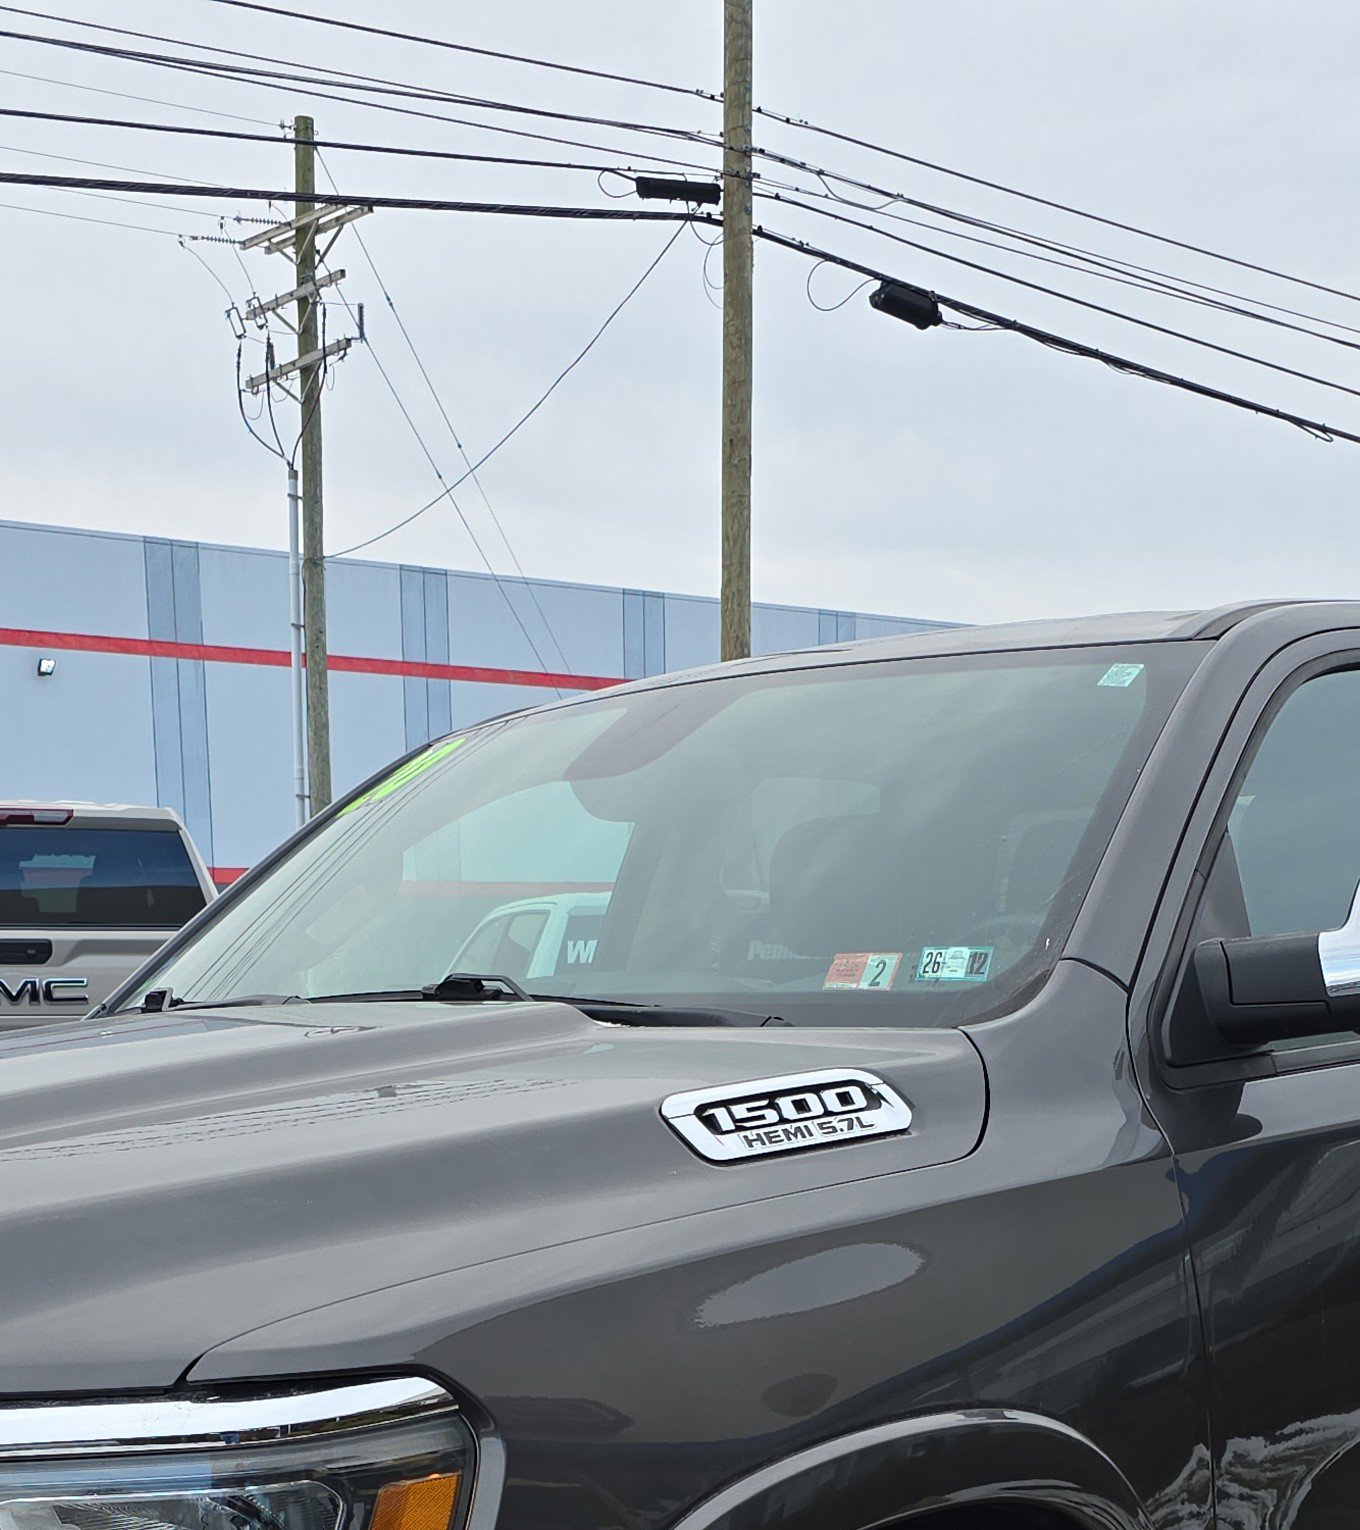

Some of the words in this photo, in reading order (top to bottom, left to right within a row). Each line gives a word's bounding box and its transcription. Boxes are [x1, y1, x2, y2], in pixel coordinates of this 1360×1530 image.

[868, 960, 886, 986] 2
[922, 952, 942, 974] 26
[968, 952, 988, 974] 12
[703, 1086, 868, 1132] 1500
[742, 1123, 814, 1149] HEMI
[819, 1114, 875, 1136] 5.7L
